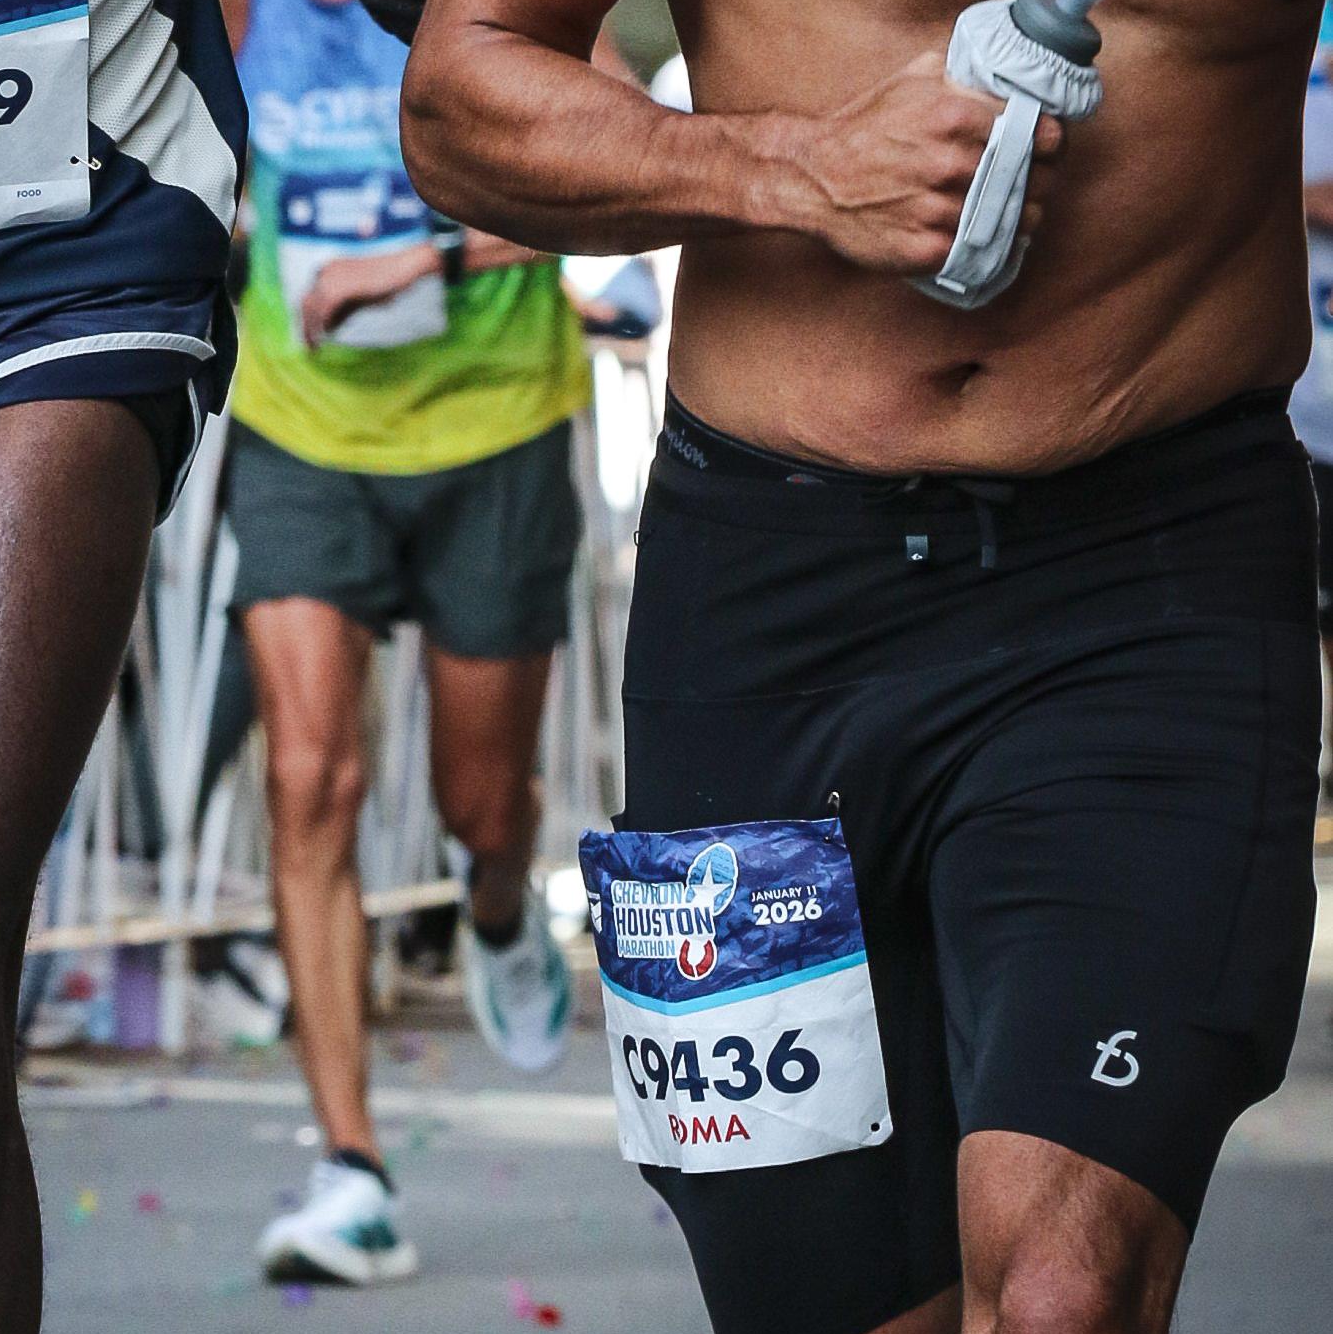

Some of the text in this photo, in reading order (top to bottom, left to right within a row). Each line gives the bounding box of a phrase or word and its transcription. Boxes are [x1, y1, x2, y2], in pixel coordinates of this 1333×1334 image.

[17, 189, 41, 198] FOOD
[613, 882, 682, 905] CHEVRON
[751, 884, 817, 902] JANUARY 11
[615, 907, 714, 937] HOUSTON
[752, 897, 823, 926] 2026
[618, 939, 676, 957] MARATHON
[623, 1028, 821, 1102] C9436
